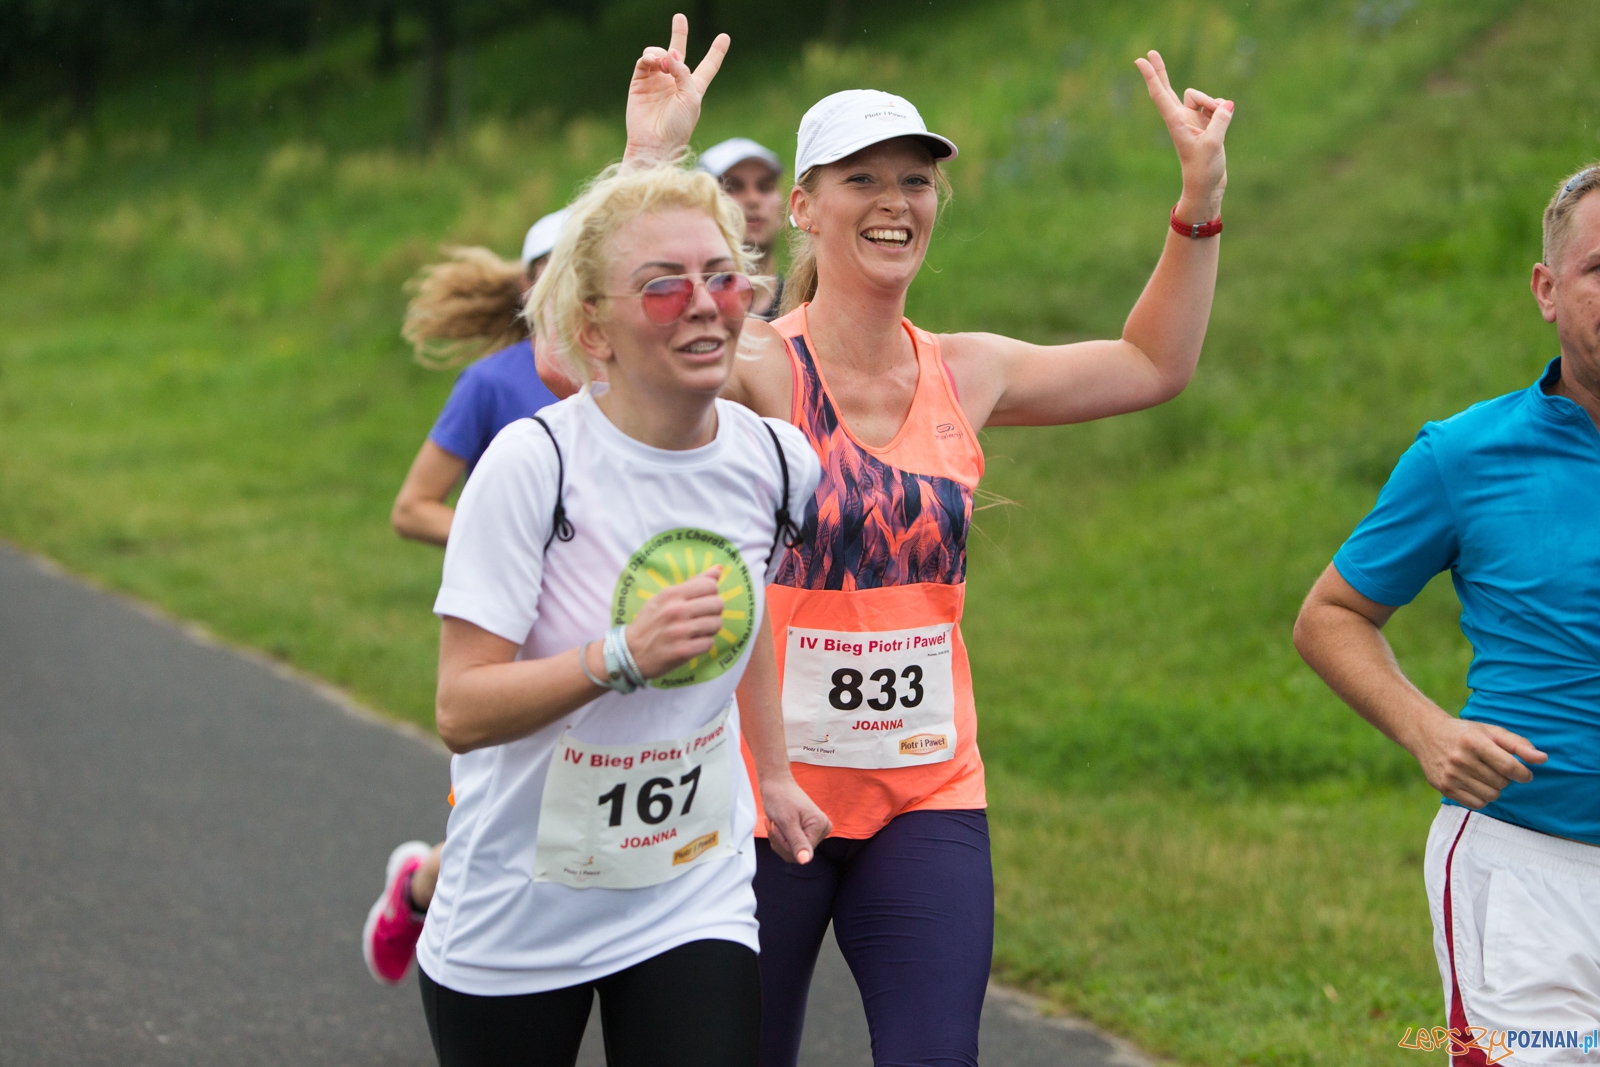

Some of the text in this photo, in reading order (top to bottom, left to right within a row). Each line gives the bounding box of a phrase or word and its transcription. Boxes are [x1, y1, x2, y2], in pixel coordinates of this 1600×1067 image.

[614, 573, 635, 625] Pomocy
[800, 631, 946, 656] IV Bieg Piotr i Paweł
[828, 664, 924, 712] 833
[852, 718, 904, 731] JOANNA
[564, 747, 584, 765] IV
[589, 754, 635, 770] Bieg
[640, 748, 683, 764] Piotr
[685, 743, 691, 755] i
[900, 741, 918, 750] Piotr
[920, 739, 924, 748] i
[924, 737, 946, 747] Paweł
[598, 764, 702, 828] 167
[620, 827, 678, 849] JOANNA
